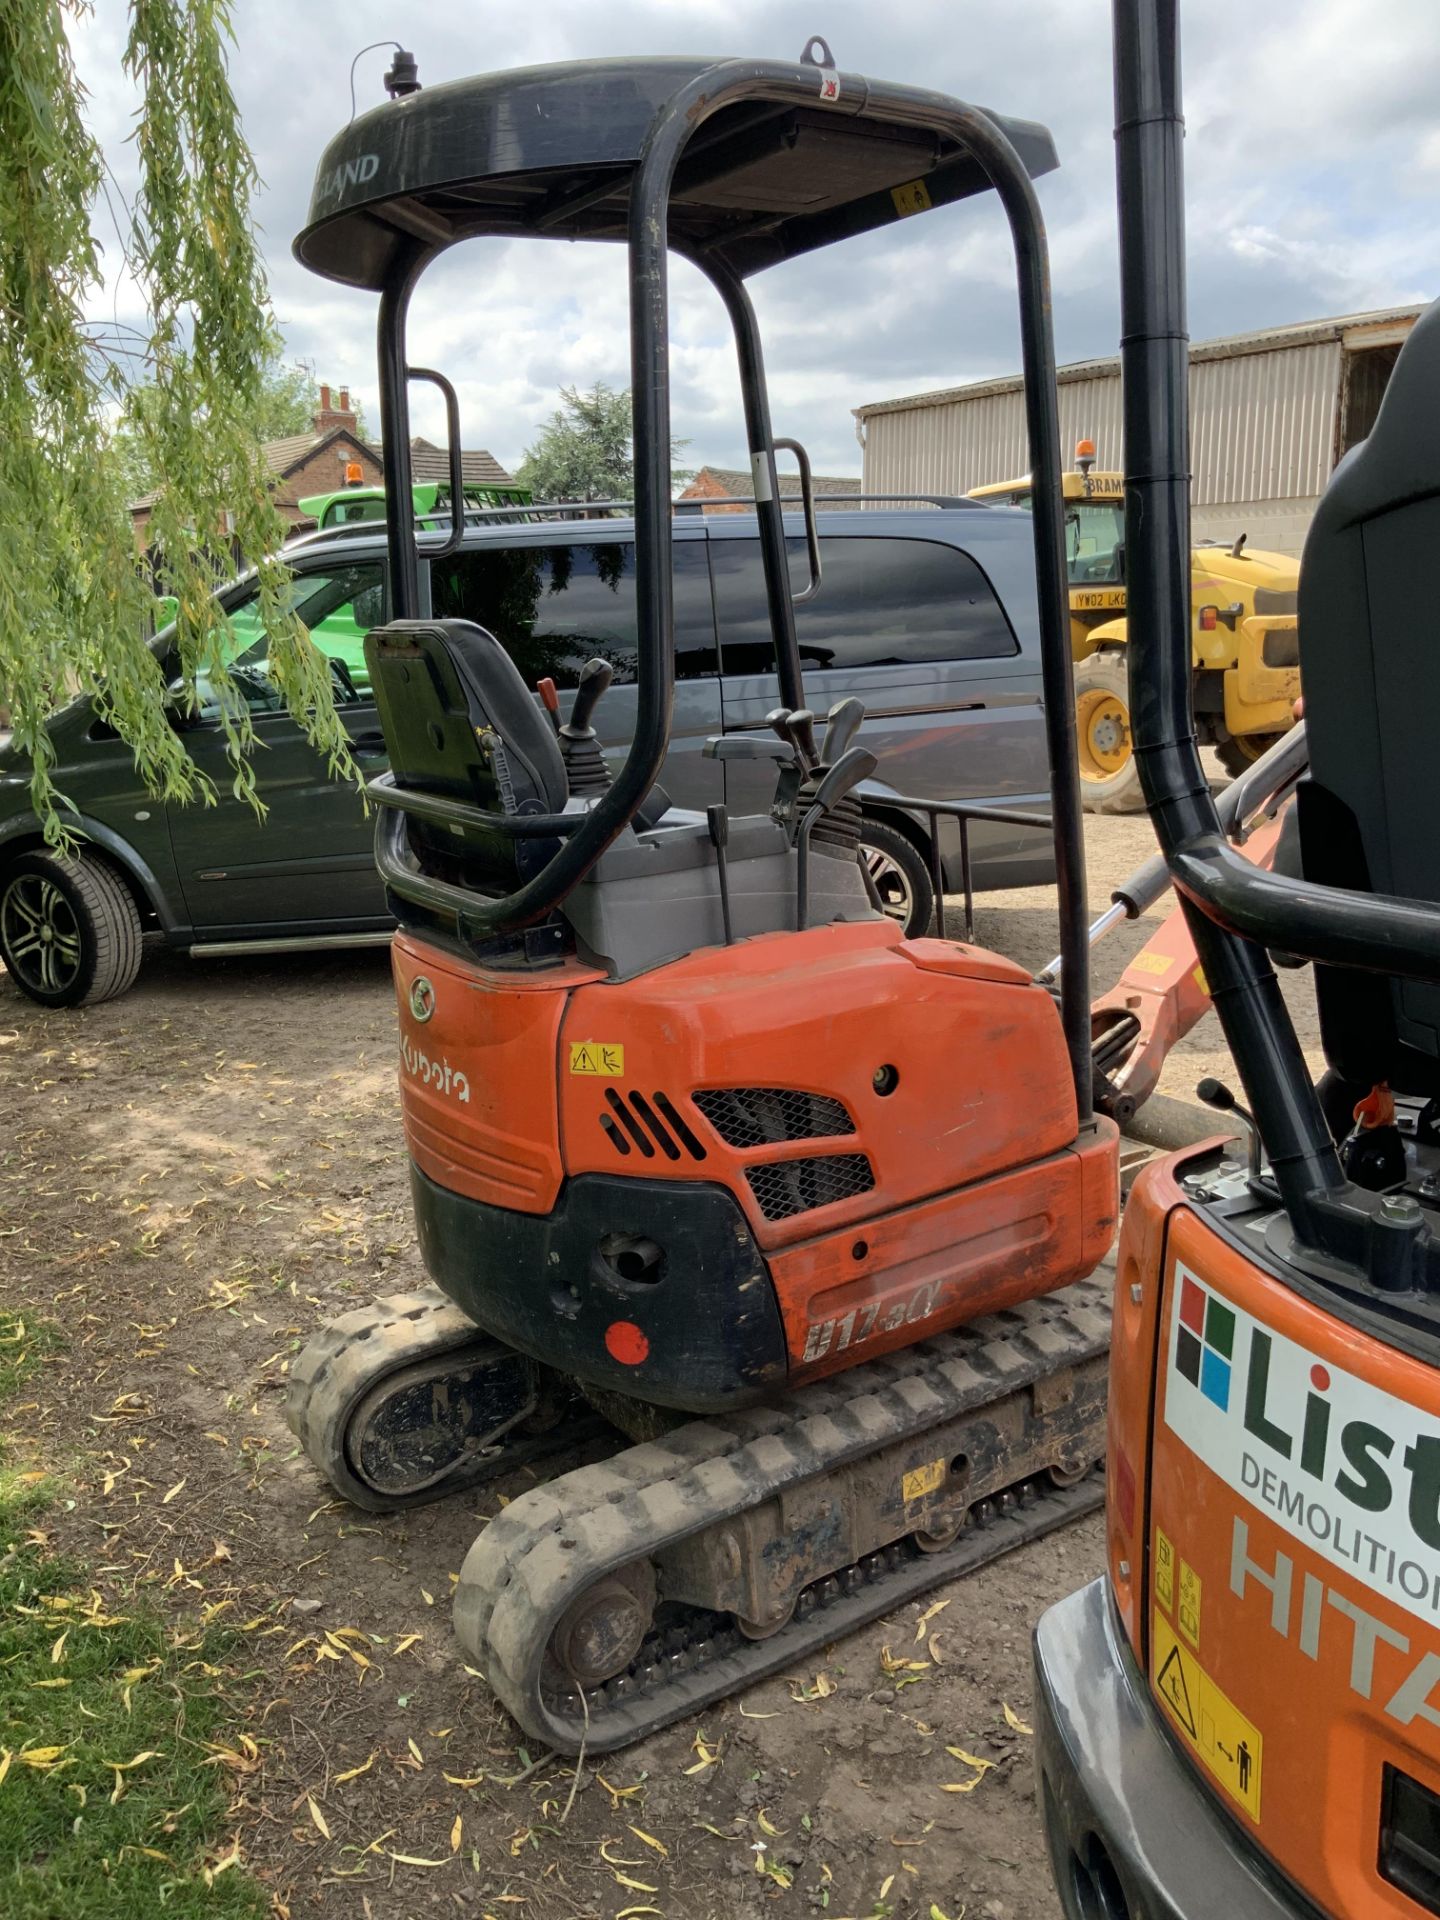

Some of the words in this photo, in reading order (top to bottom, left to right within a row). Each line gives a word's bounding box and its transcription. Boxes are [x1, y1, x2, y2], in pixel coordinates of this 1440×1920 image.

[317, 154, 380, 197] LAND
[1089, 478, 1125, 493] BRAM
[399, 1029, 469, 1103] Kubota
